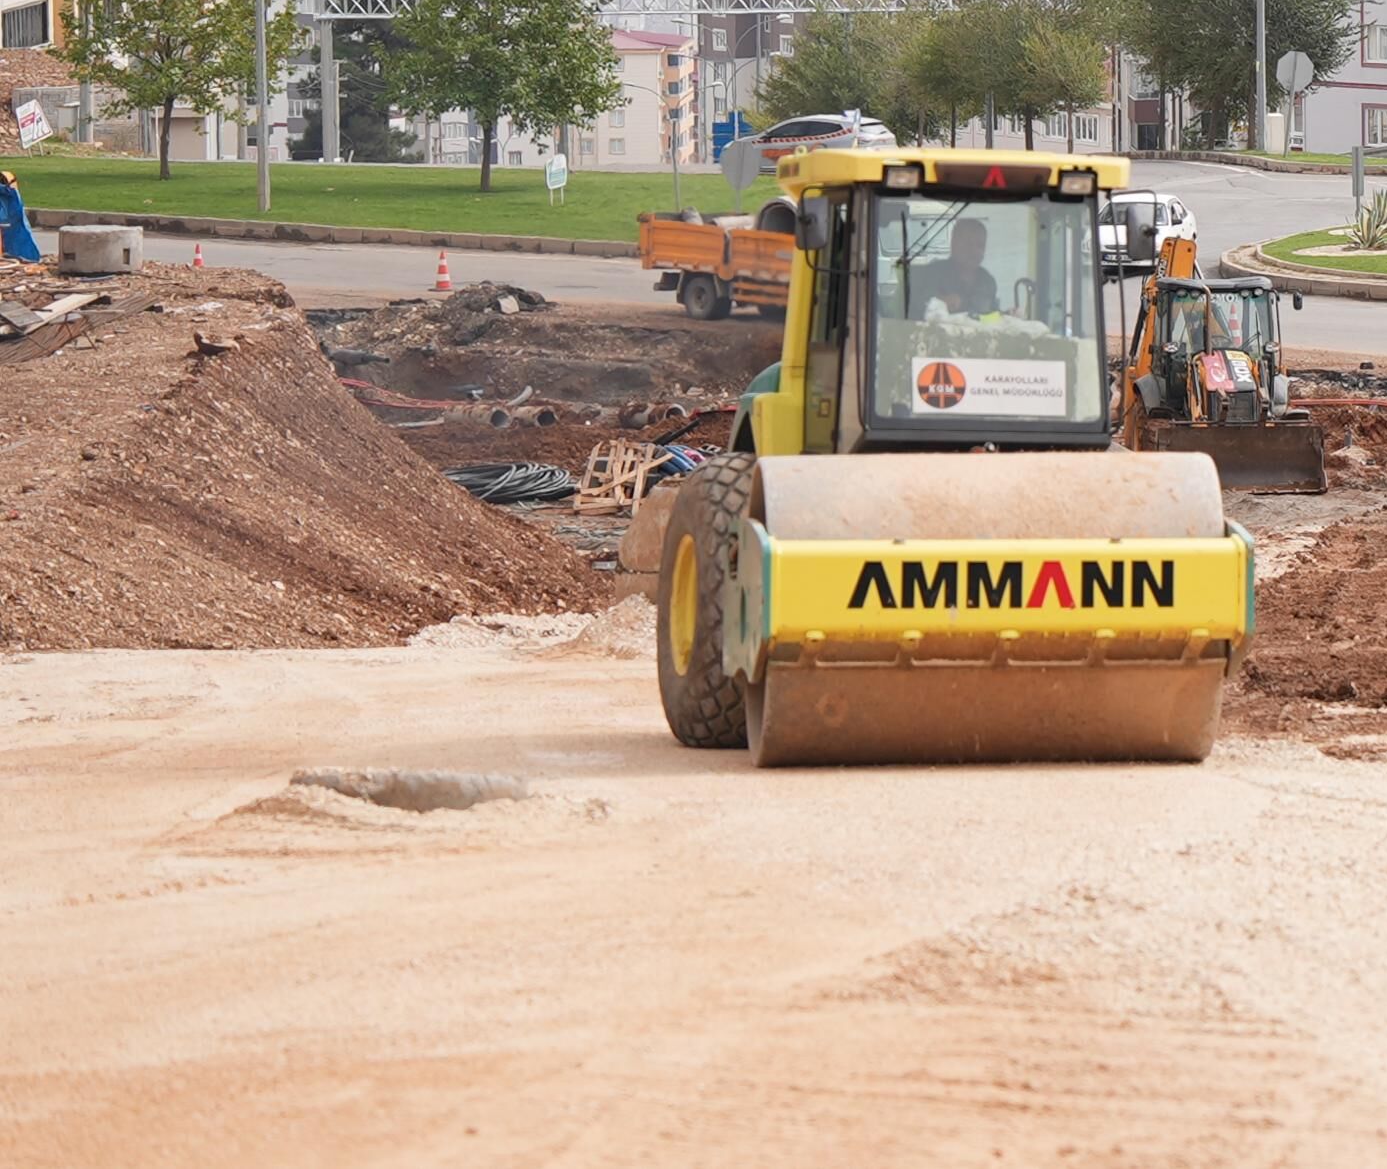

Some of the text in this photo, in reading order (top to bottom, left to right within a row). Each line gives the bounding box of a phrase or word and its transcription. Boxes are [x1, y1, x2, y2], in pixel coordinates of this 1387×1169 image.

[984, 376, 1048, 384] KARAYOLLARI
[928, 384, 955, 393] KGM
[970, 387, 1000, 396] GENEL
[848, 560, 1174, 609] AMMANN
